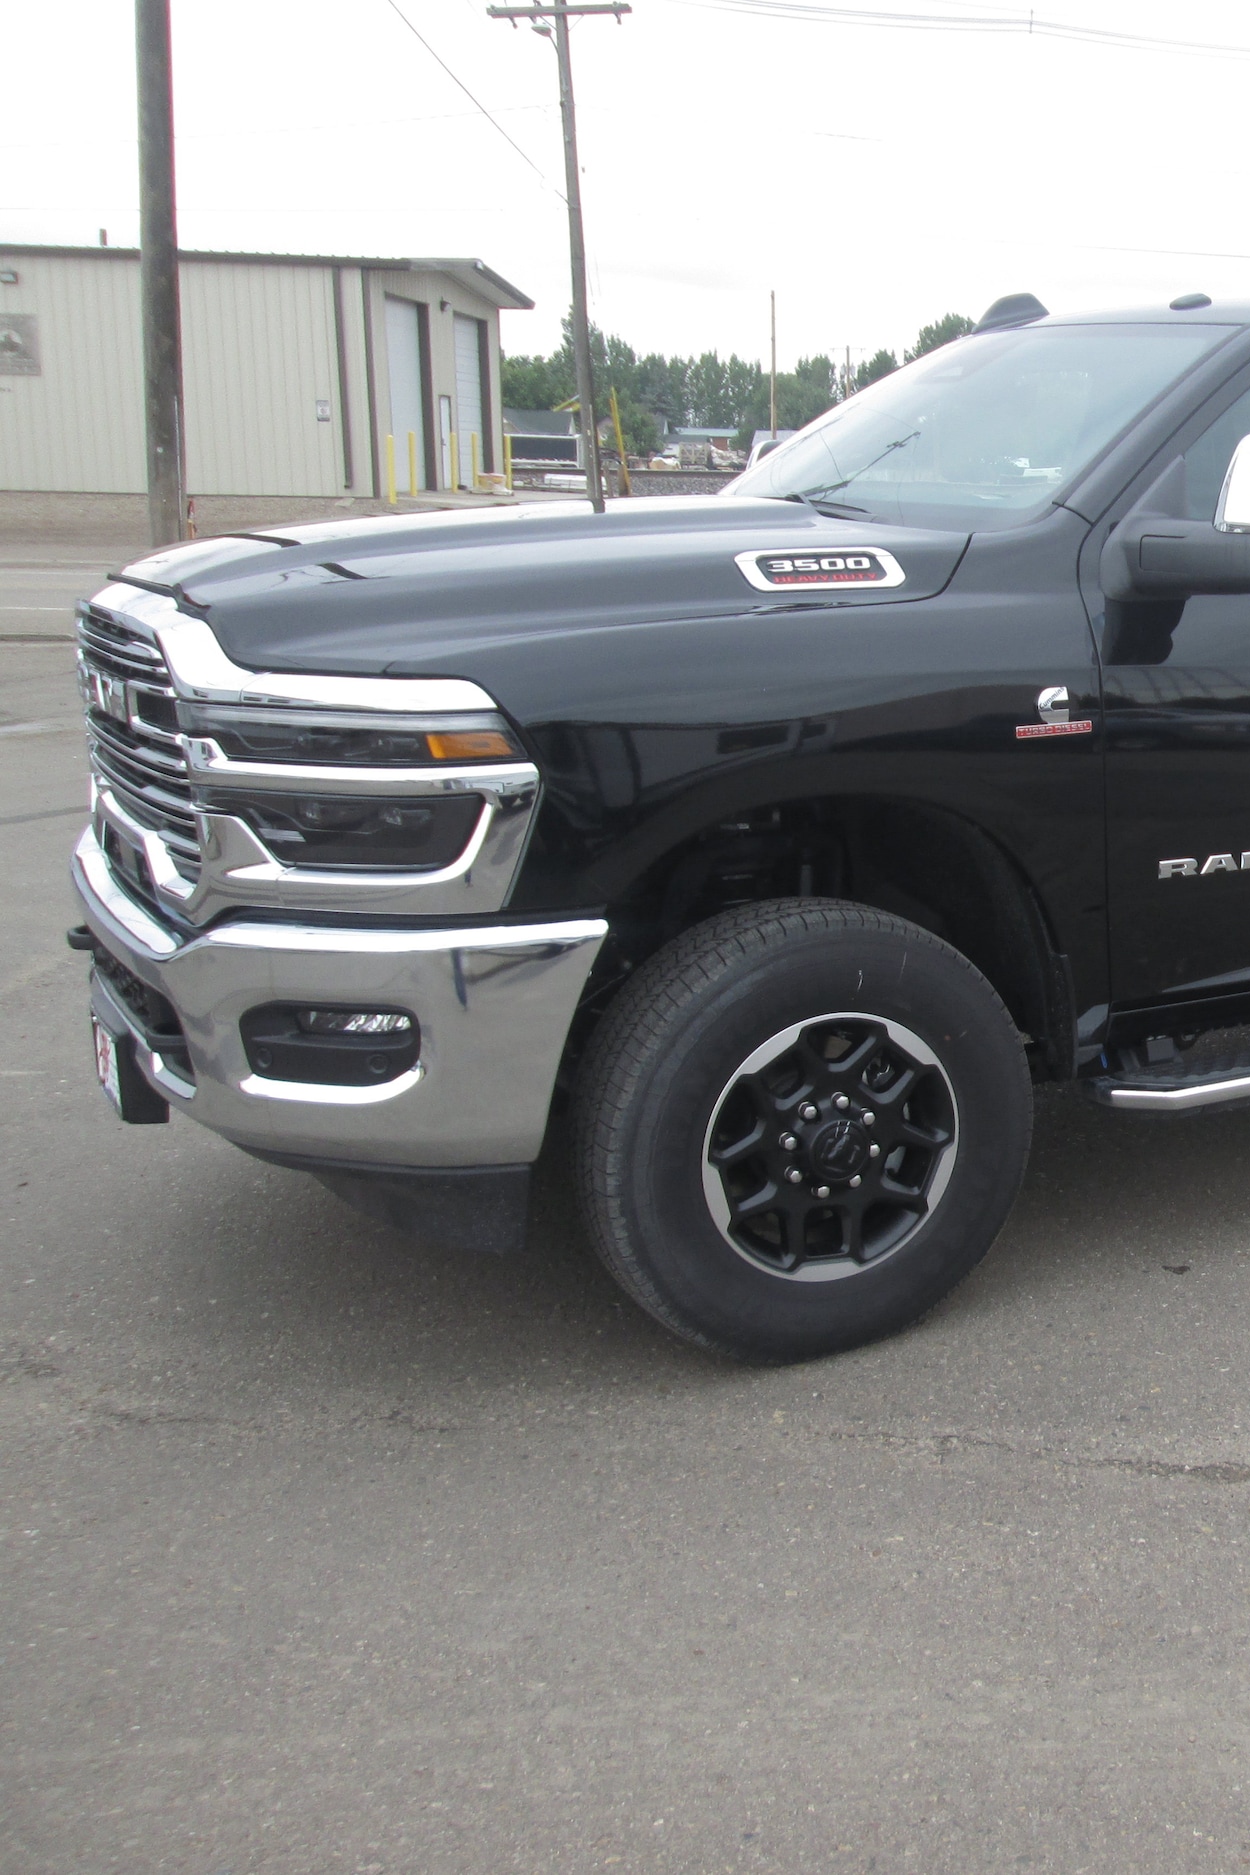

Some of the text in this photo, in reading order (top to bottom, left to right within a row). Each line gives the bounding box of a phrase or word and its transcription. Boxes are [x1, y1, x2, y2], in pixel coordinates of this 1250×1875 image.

[767, 557, 871, 572] 3500
[773, 572, 877, 583] HEAVY DUTY
[1039, 687, 1065, 710] Cummins
[1018, 722, 1090, 736] TURBO DIESEL
